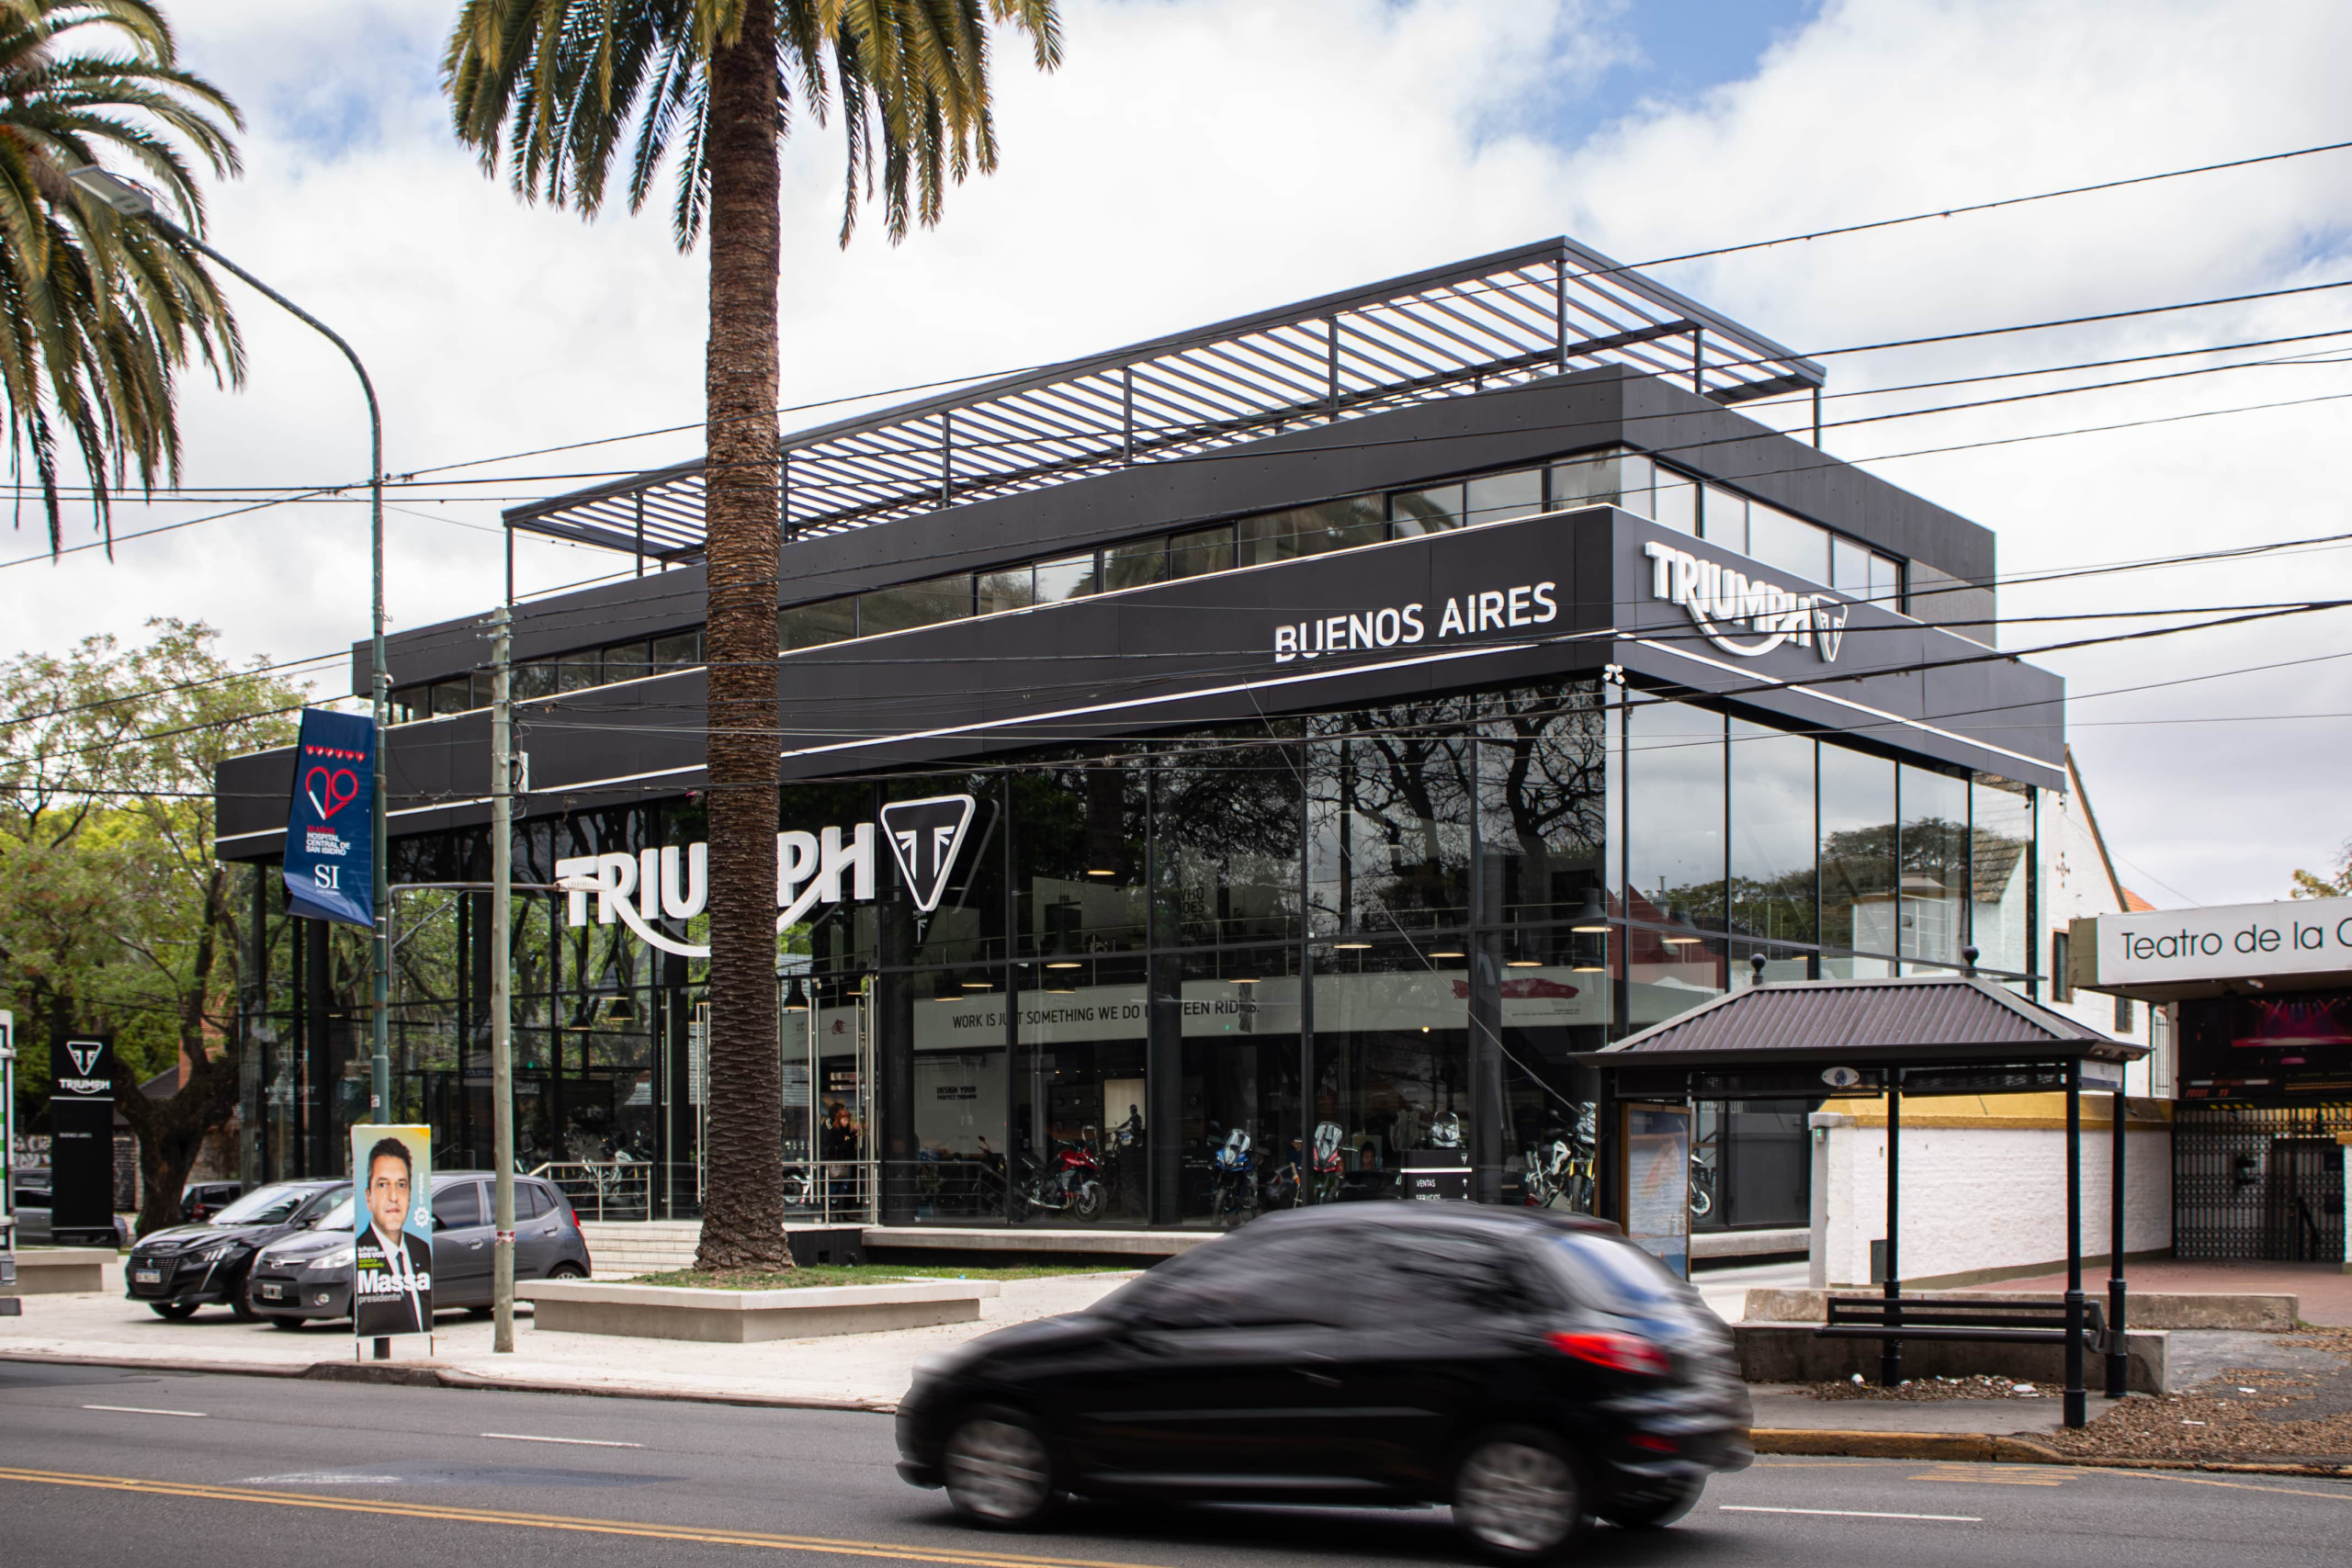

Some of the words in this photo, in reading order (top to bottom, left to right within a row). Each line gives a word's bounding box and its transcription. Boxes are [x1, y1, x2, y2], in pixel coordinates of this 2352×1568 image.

[1645, 541, 1812, 657] TRIUMPH
[1274, 604, 1424, 663] BUENOS
[1438, 581, 1557, 637] AIRES
[306, 840, 339, 849] CENTRAL
[340, 842, 351, 851] DE
[307, 832, 340, 842] HOSPITAL
[305, 846, 321, 854] SAN
[322, 847, 347, 856] ISIDRO
[314, 863, 341, 890] SI
[555, 822, 875, 957] TRIUPH
[2120, 928, 2223, 961] Teatro
[2233, 923, 2282, 953] de
[2293, 920, 2324, 950] la
[952, 1013, 983, 1029] WORK
[986, 1012, 996, 1026] IS
[998, 1010, 1023, 1026] JUT
[1026, 1007, 1094, 1025] SOMETHING
[1098, 1006, 1118, 1021] WE
[1122, 1005, 1140, 1019] DO
[58, 1077, 111, 1094] TRIUMPH
[1416, 1179, 1436, 1188] VENTAS
[356, 1269, 431, 1293] Massa
[357, 1293, 402, 1305] presidente
